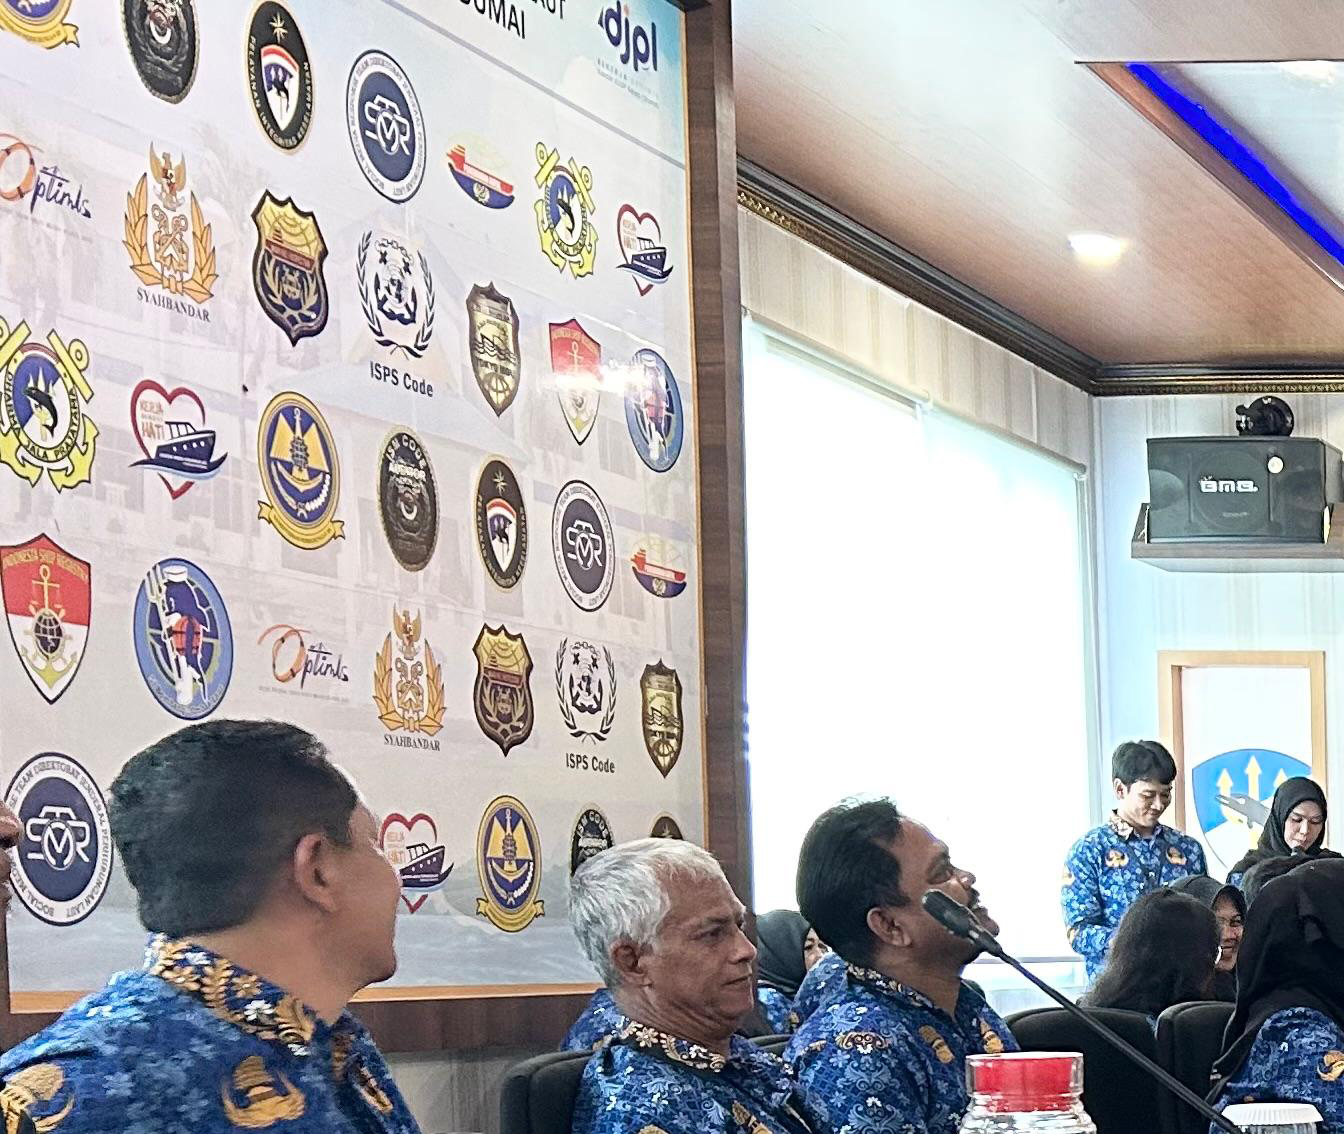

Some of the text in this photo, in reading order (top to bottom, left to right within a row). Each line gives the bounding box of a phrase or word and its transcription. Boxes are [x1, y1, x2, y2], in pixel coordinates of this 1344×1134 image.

[459, 0, 526, 39] UMAI
[137, 287, 210, 322] SYAHBANDAR
[370, 361, 433, 398] ISPS Code
[384, 733, 440, 751] SYAHBANDAR
[566, 752, 615, 773] ISPS Code
